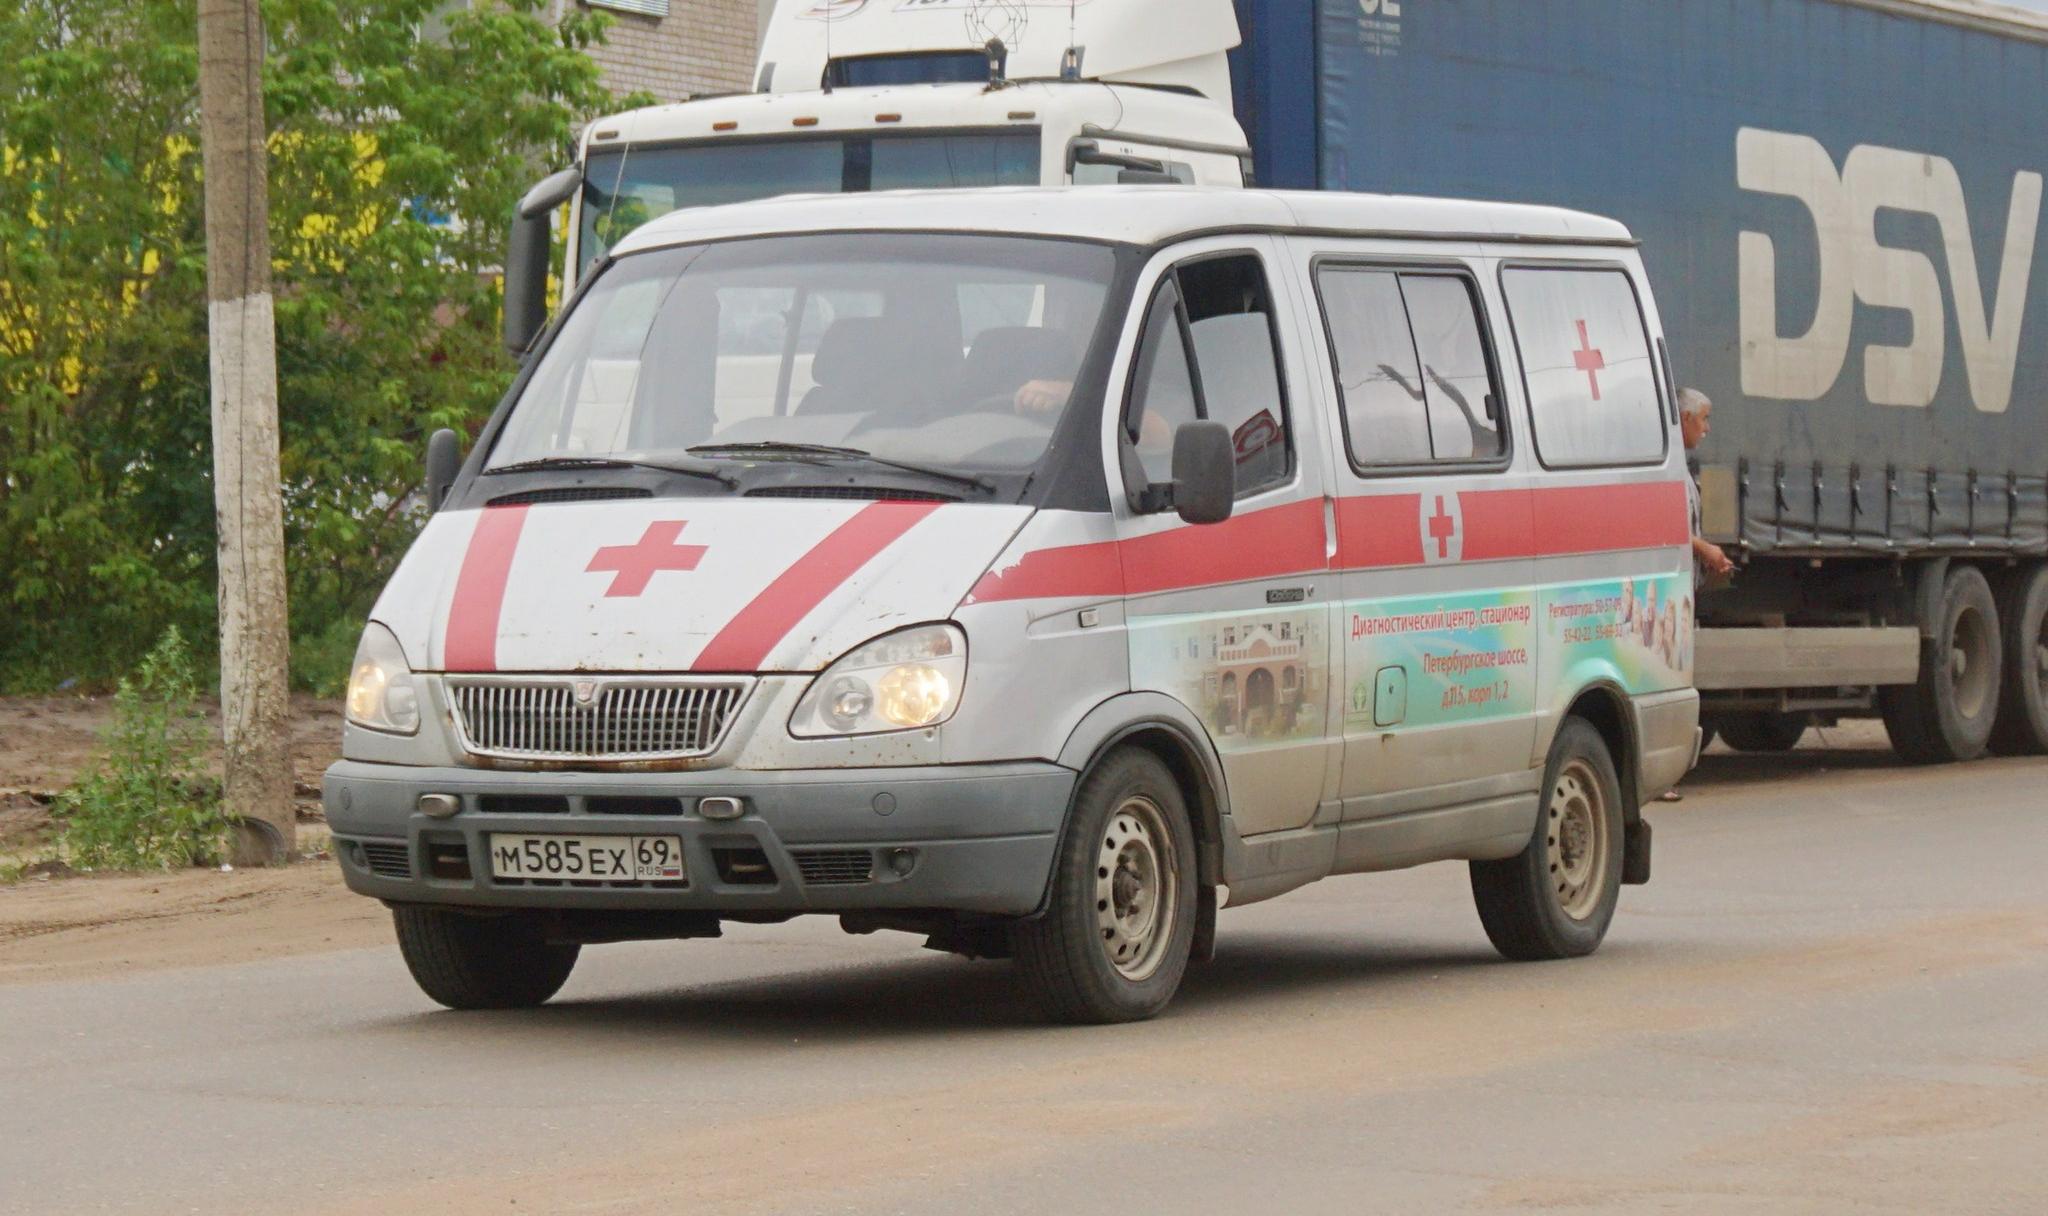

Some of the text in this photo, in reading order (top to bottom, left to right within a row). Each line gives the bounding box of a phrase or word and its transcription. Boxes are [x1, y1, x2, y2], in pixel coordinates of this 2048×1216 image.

[1736, 126, 2043, 413] DSV
[1352, 605, 1531, 641] Диагностический центр, стационар
[1424, 649, 1496, 676] Петербургское
[638, 839, 669, 866] 69
[638, 866, 661, 876] RUS
